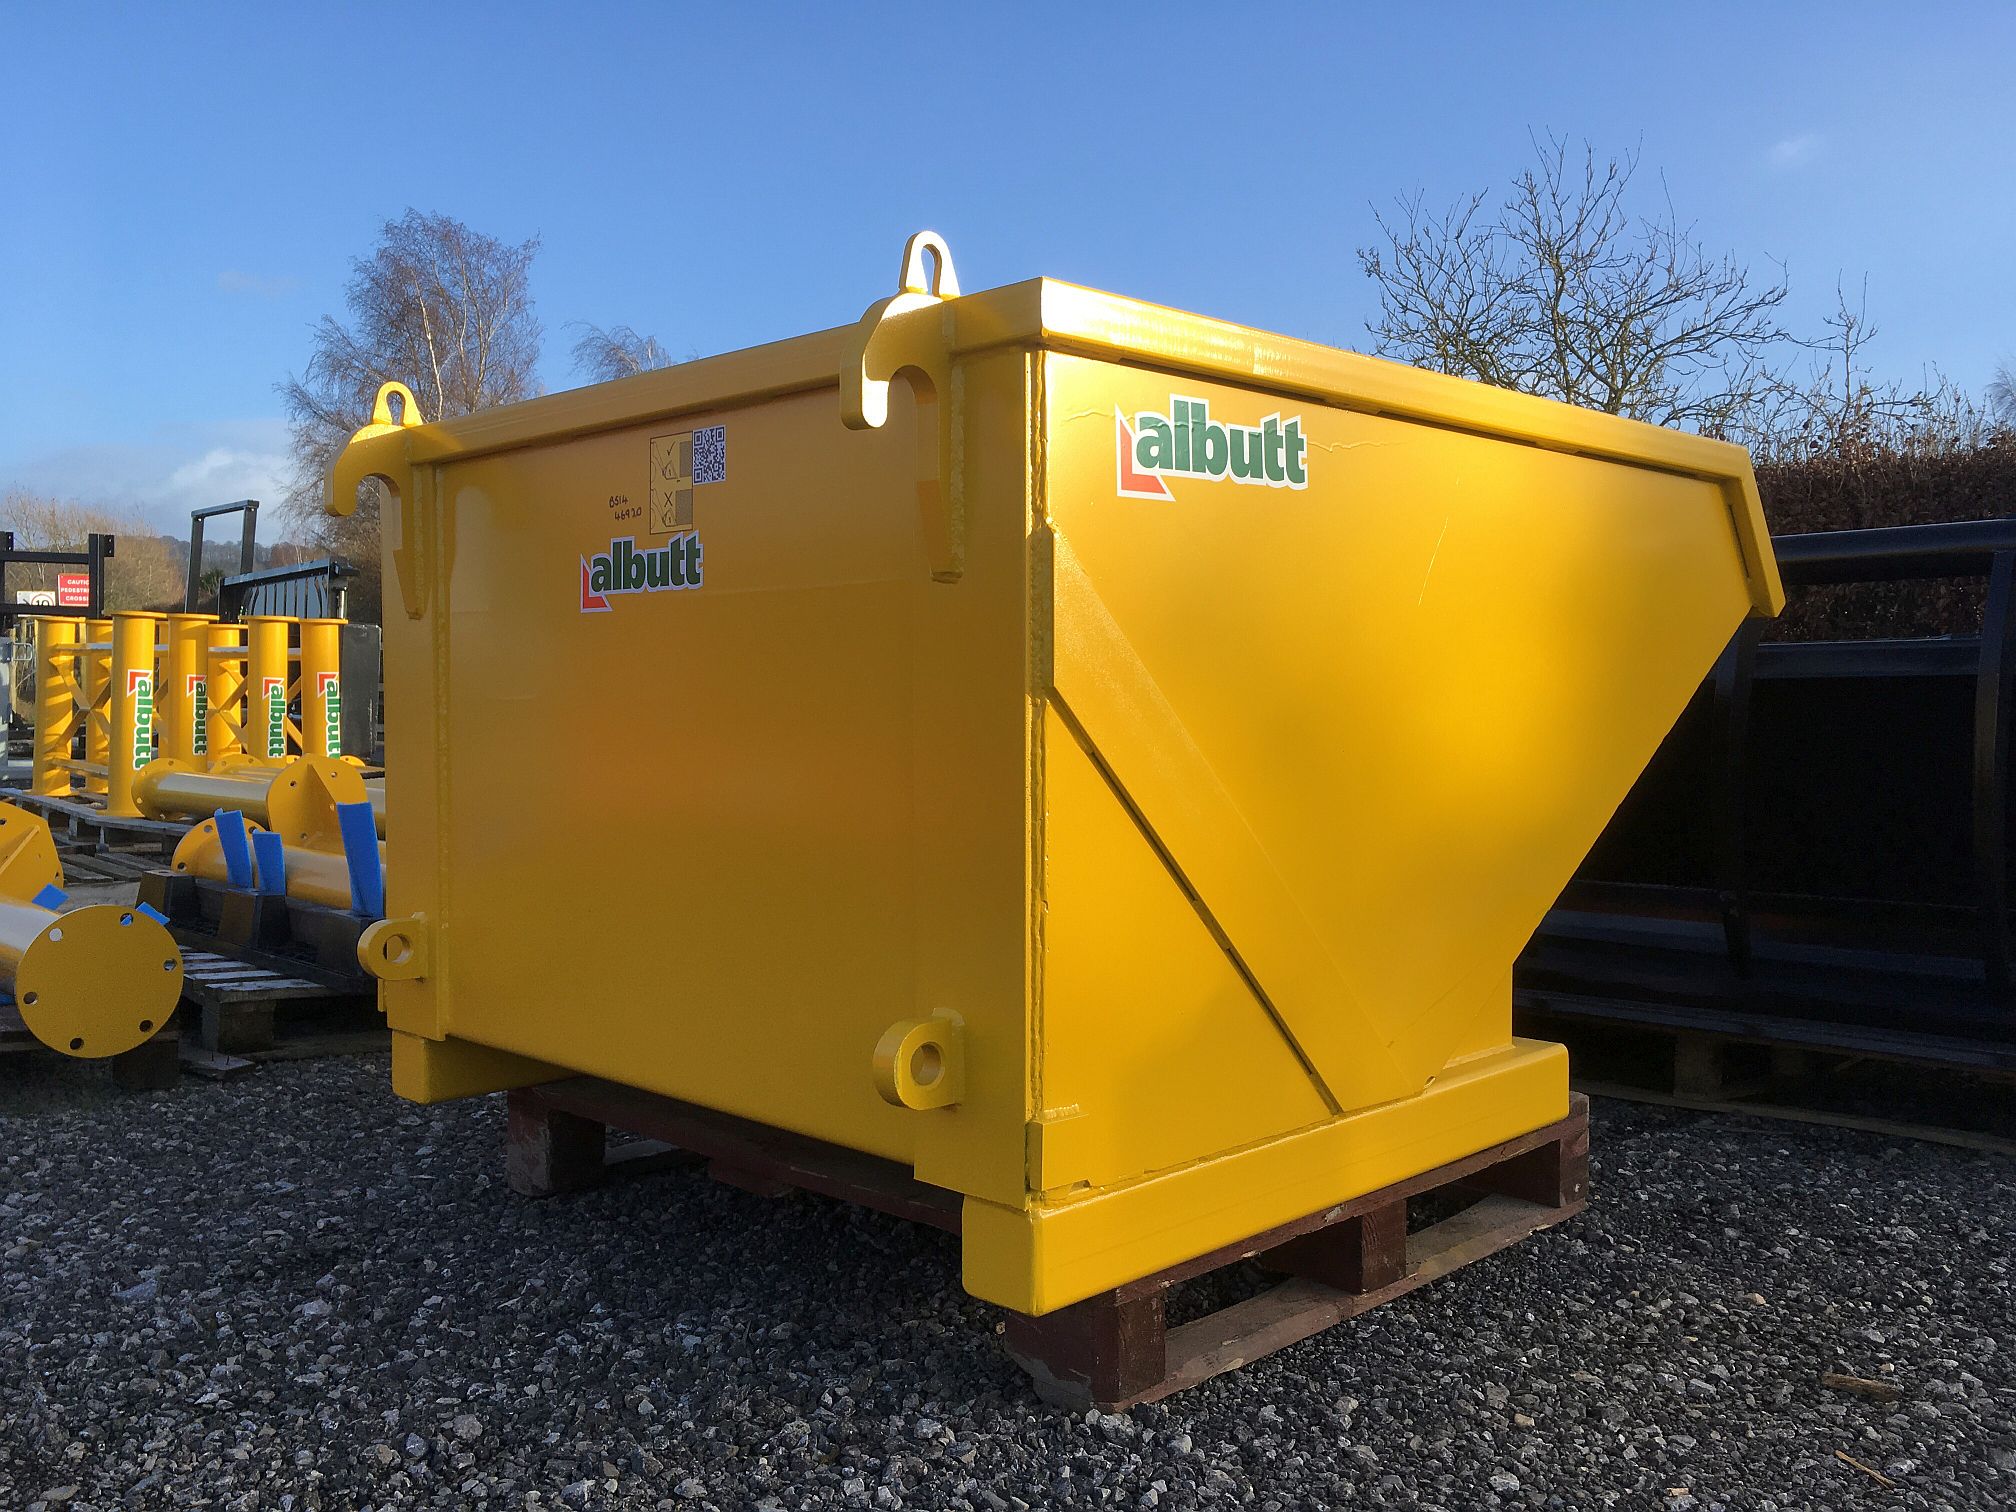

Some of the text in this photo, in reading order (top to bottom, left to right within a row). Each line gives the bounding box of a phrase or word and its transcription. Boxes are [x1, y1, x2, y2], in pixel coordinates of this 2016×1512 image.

[1135, 398, 1307, 485] albutt
[590, 535, 702, 593] albutt
[194, 681, 208, 754] albutt
[268, 685, 286, 757] albutt
